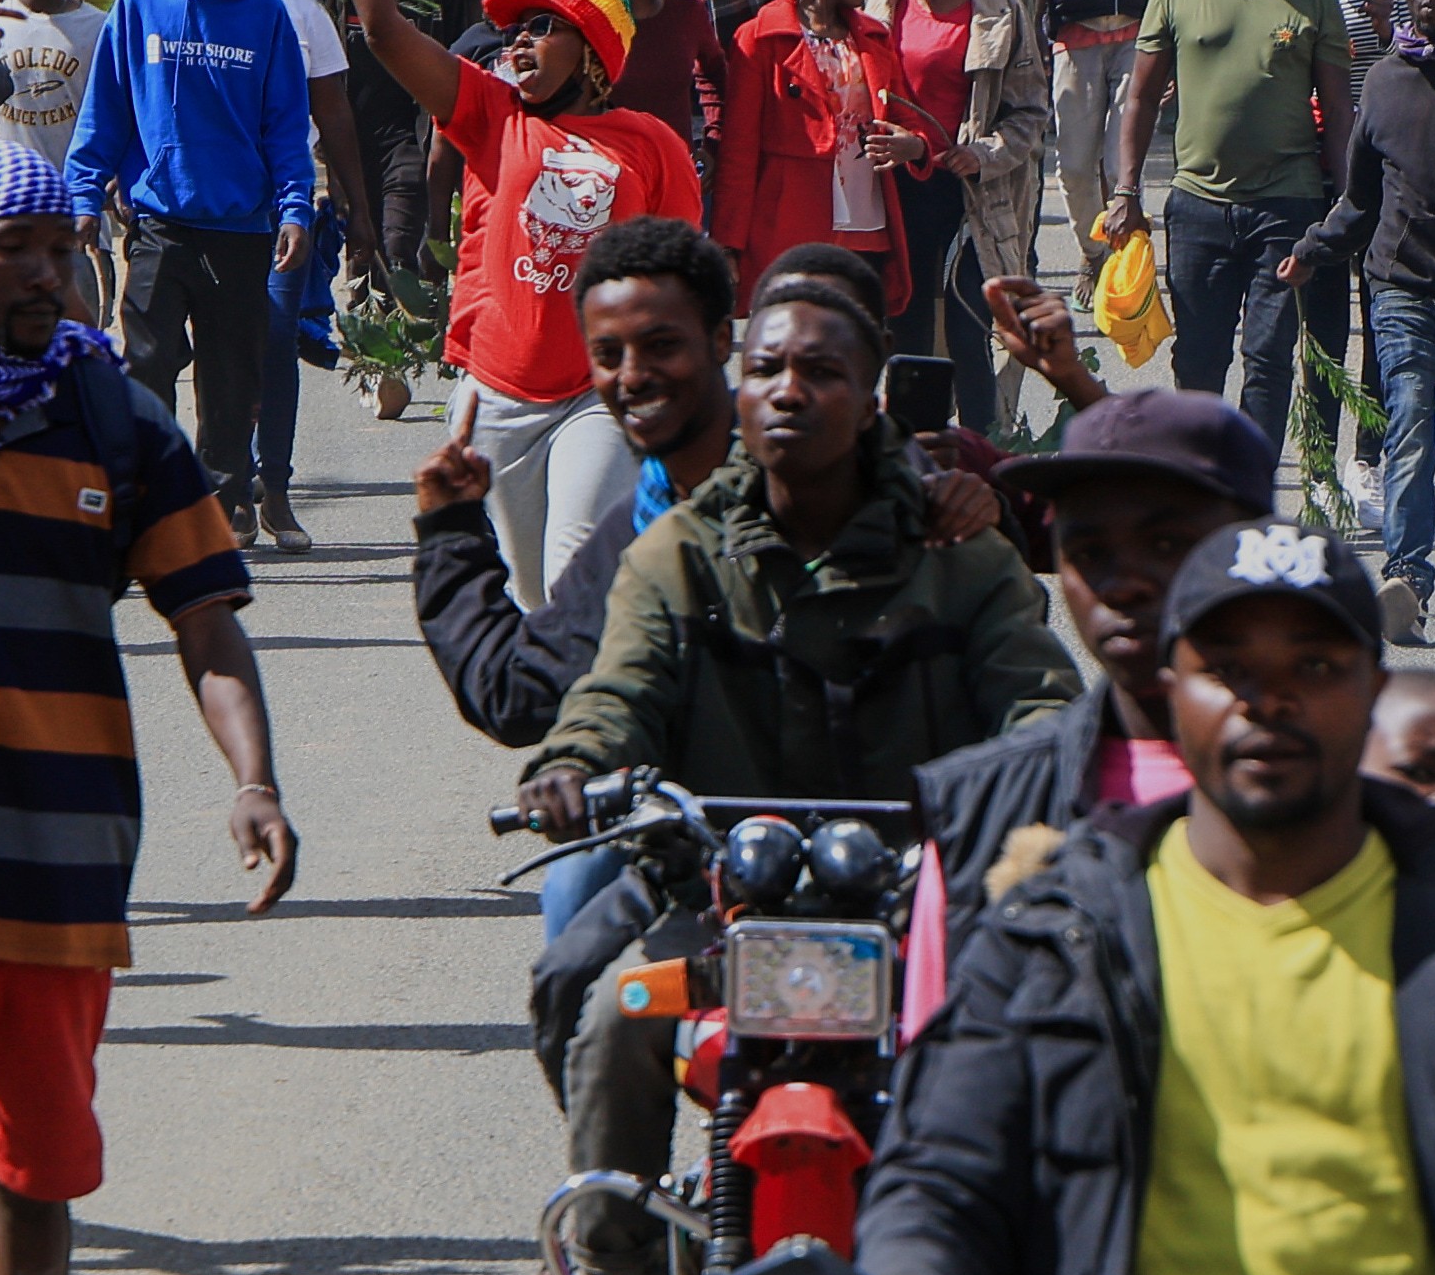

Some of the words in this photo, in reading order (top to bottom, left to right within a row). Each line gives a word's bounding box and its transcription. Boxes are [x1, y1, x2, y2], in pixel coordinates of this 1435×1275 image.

[161, 40, 205, 57] WEST
[205, 43, 255, 64] SHORE
[185, 56, 229, 70] HOME
[40, 102, 78, 126] TEAM
[514, 255, 556, 294] Cozy
